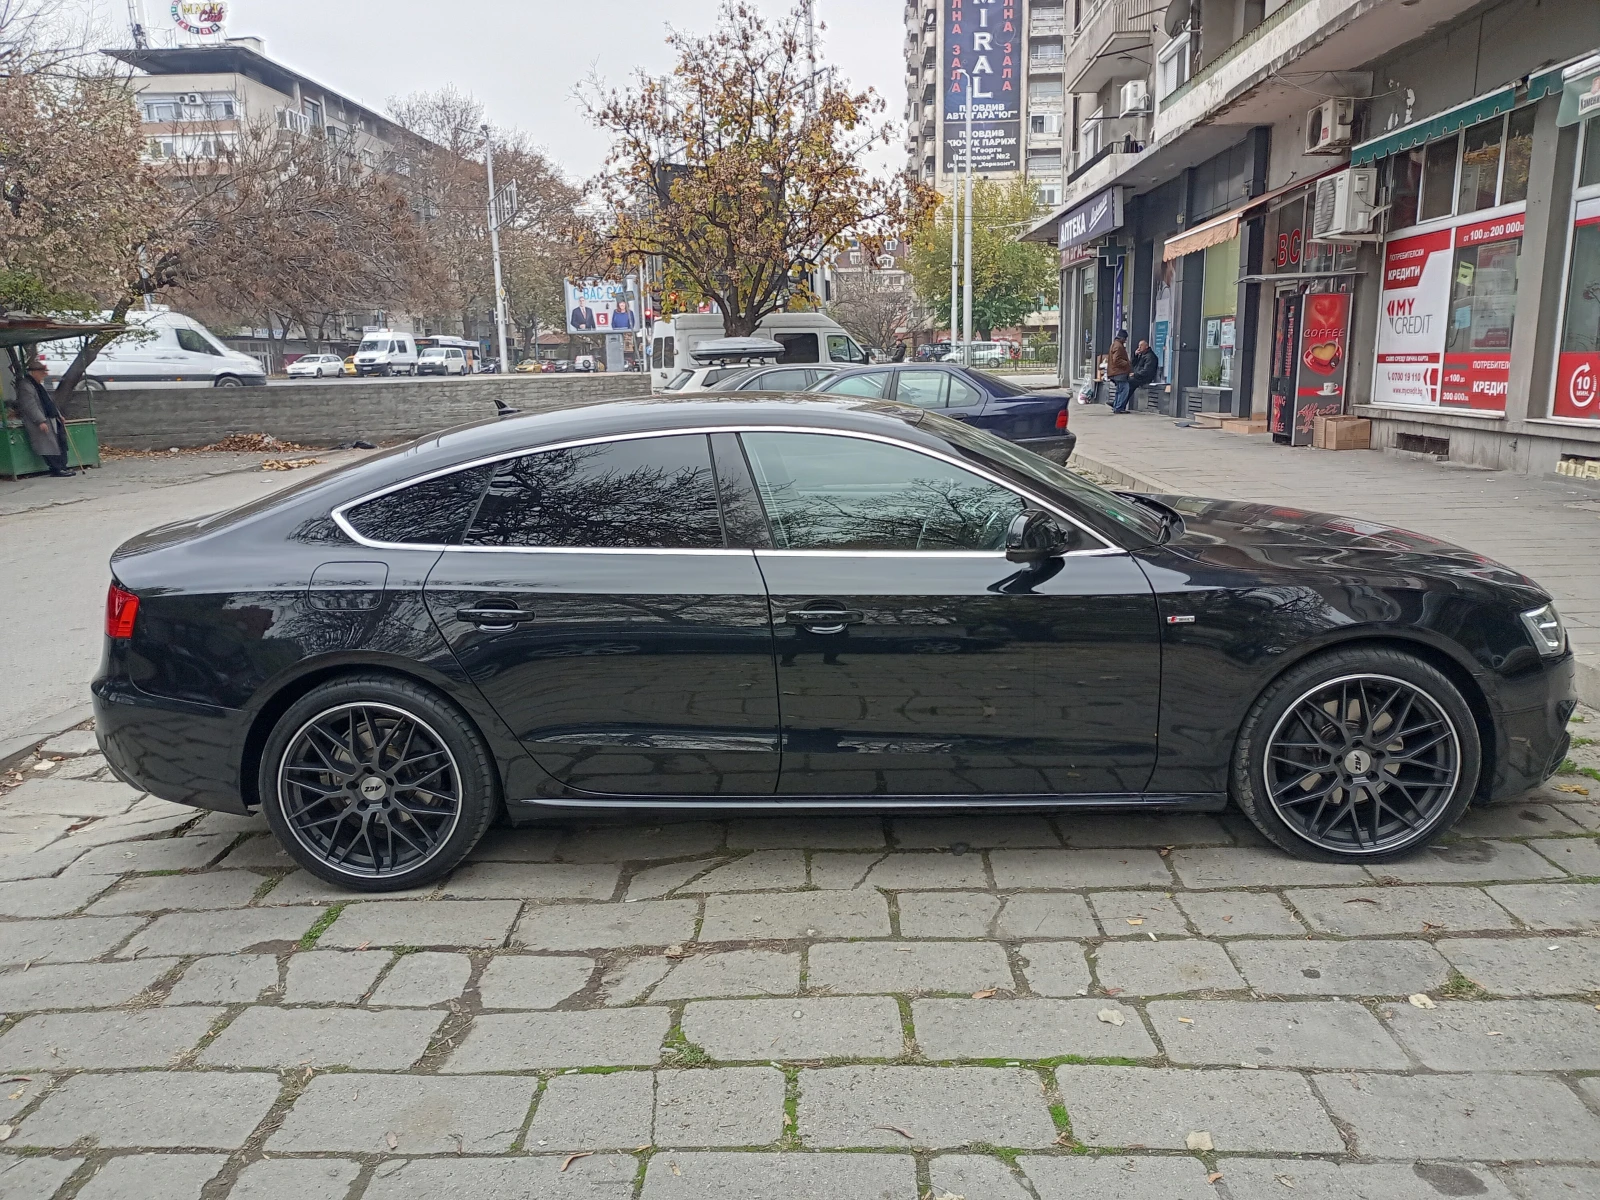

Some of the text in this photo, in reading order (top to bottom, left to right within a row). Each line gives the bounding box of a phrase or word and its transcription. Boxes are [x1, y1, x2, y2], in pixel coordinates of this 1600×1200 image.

[972, 0, 994, 99] IRAL
[1002, 42, 1012, 91] ЗАЛА
[959, 103, 1005, 112] ПОВДИВ
[959, 129, 1005, 138] ПОВДИВ
[982, 137, 1016, 146] ПАРИЖ
[1060, 212, 1087, 244] АПТЕКА
[1470, 229, 1483, 241] 100
[1490, 225, 1504, 237] 200
[1387, 265, 1421, 281] КРЕДИТИ
[1396, 298, 1415, 316] MY
[599, 315, 606, 324] 6
[1394, 314, 1433, 334] CREDIT
[1303, 328, 1345, 338] COFFEE
[1576, 376, 1590, 390] 10
